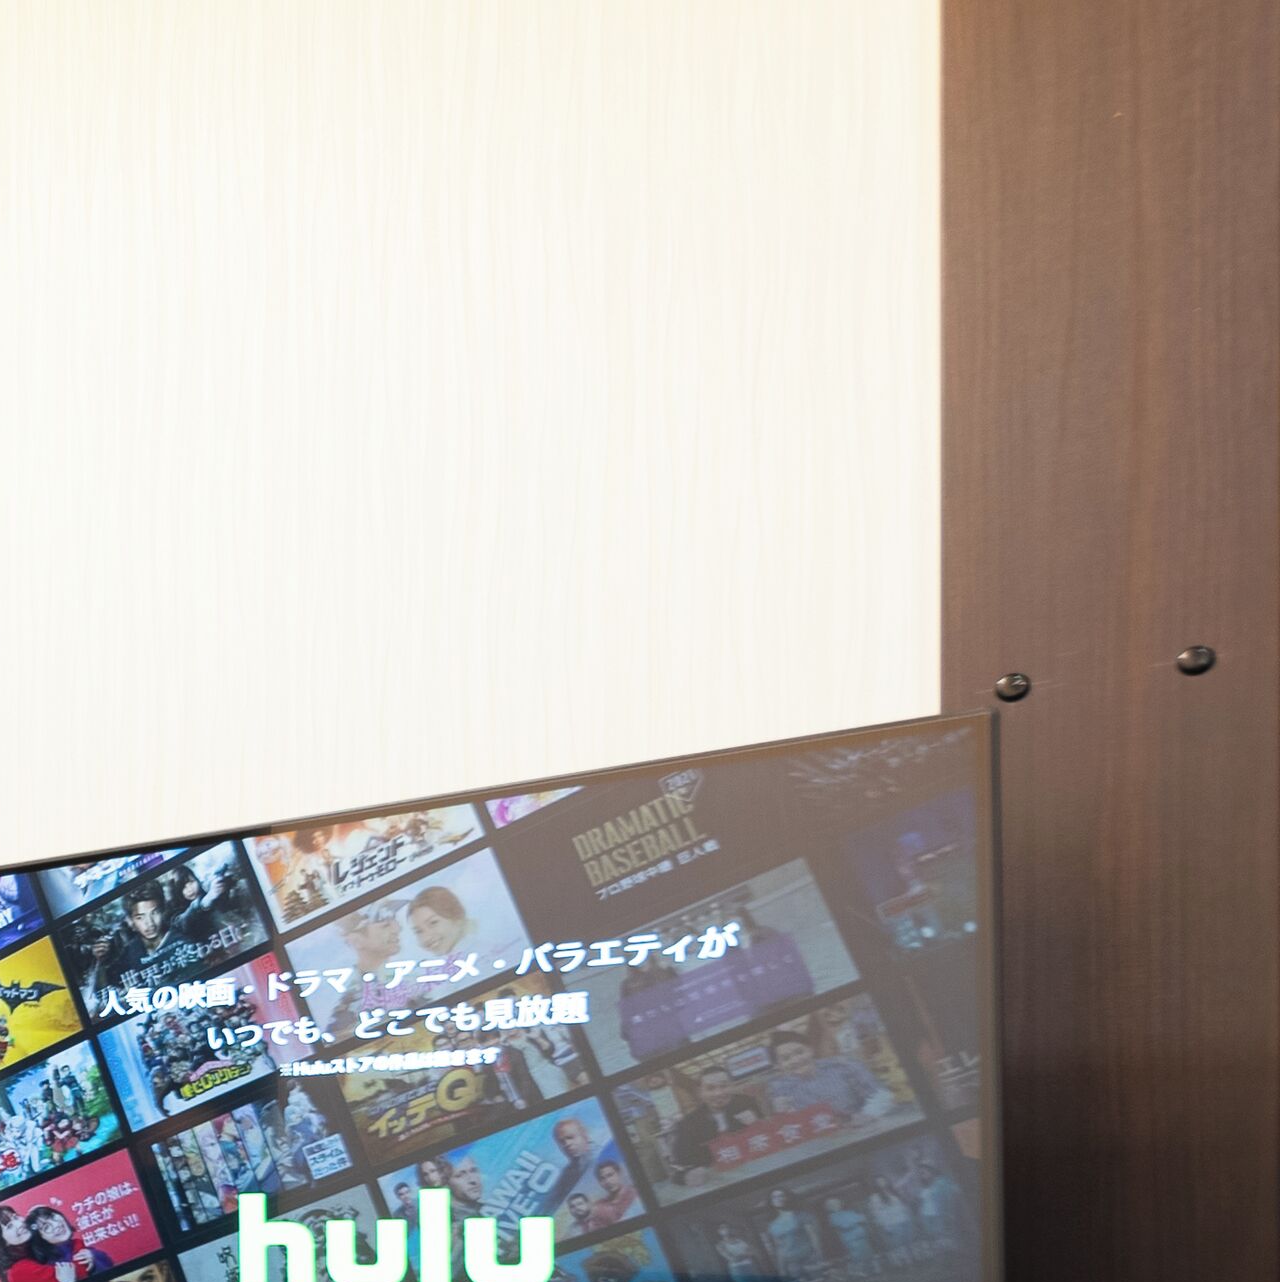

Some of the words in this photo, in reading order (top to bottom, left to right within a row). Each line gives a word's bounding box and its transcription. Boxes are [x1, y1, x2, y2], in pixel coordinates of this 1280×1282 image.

[572, 793, 694, 861] DRAMATIC
[583, 818, 707, 888] BASEBALL
[98, 921, 740, 1018] 人気の映画・ドラマ・アニメ・バラエティが
[206, 990, 591, 1052] いつでも、どこでも見放題
